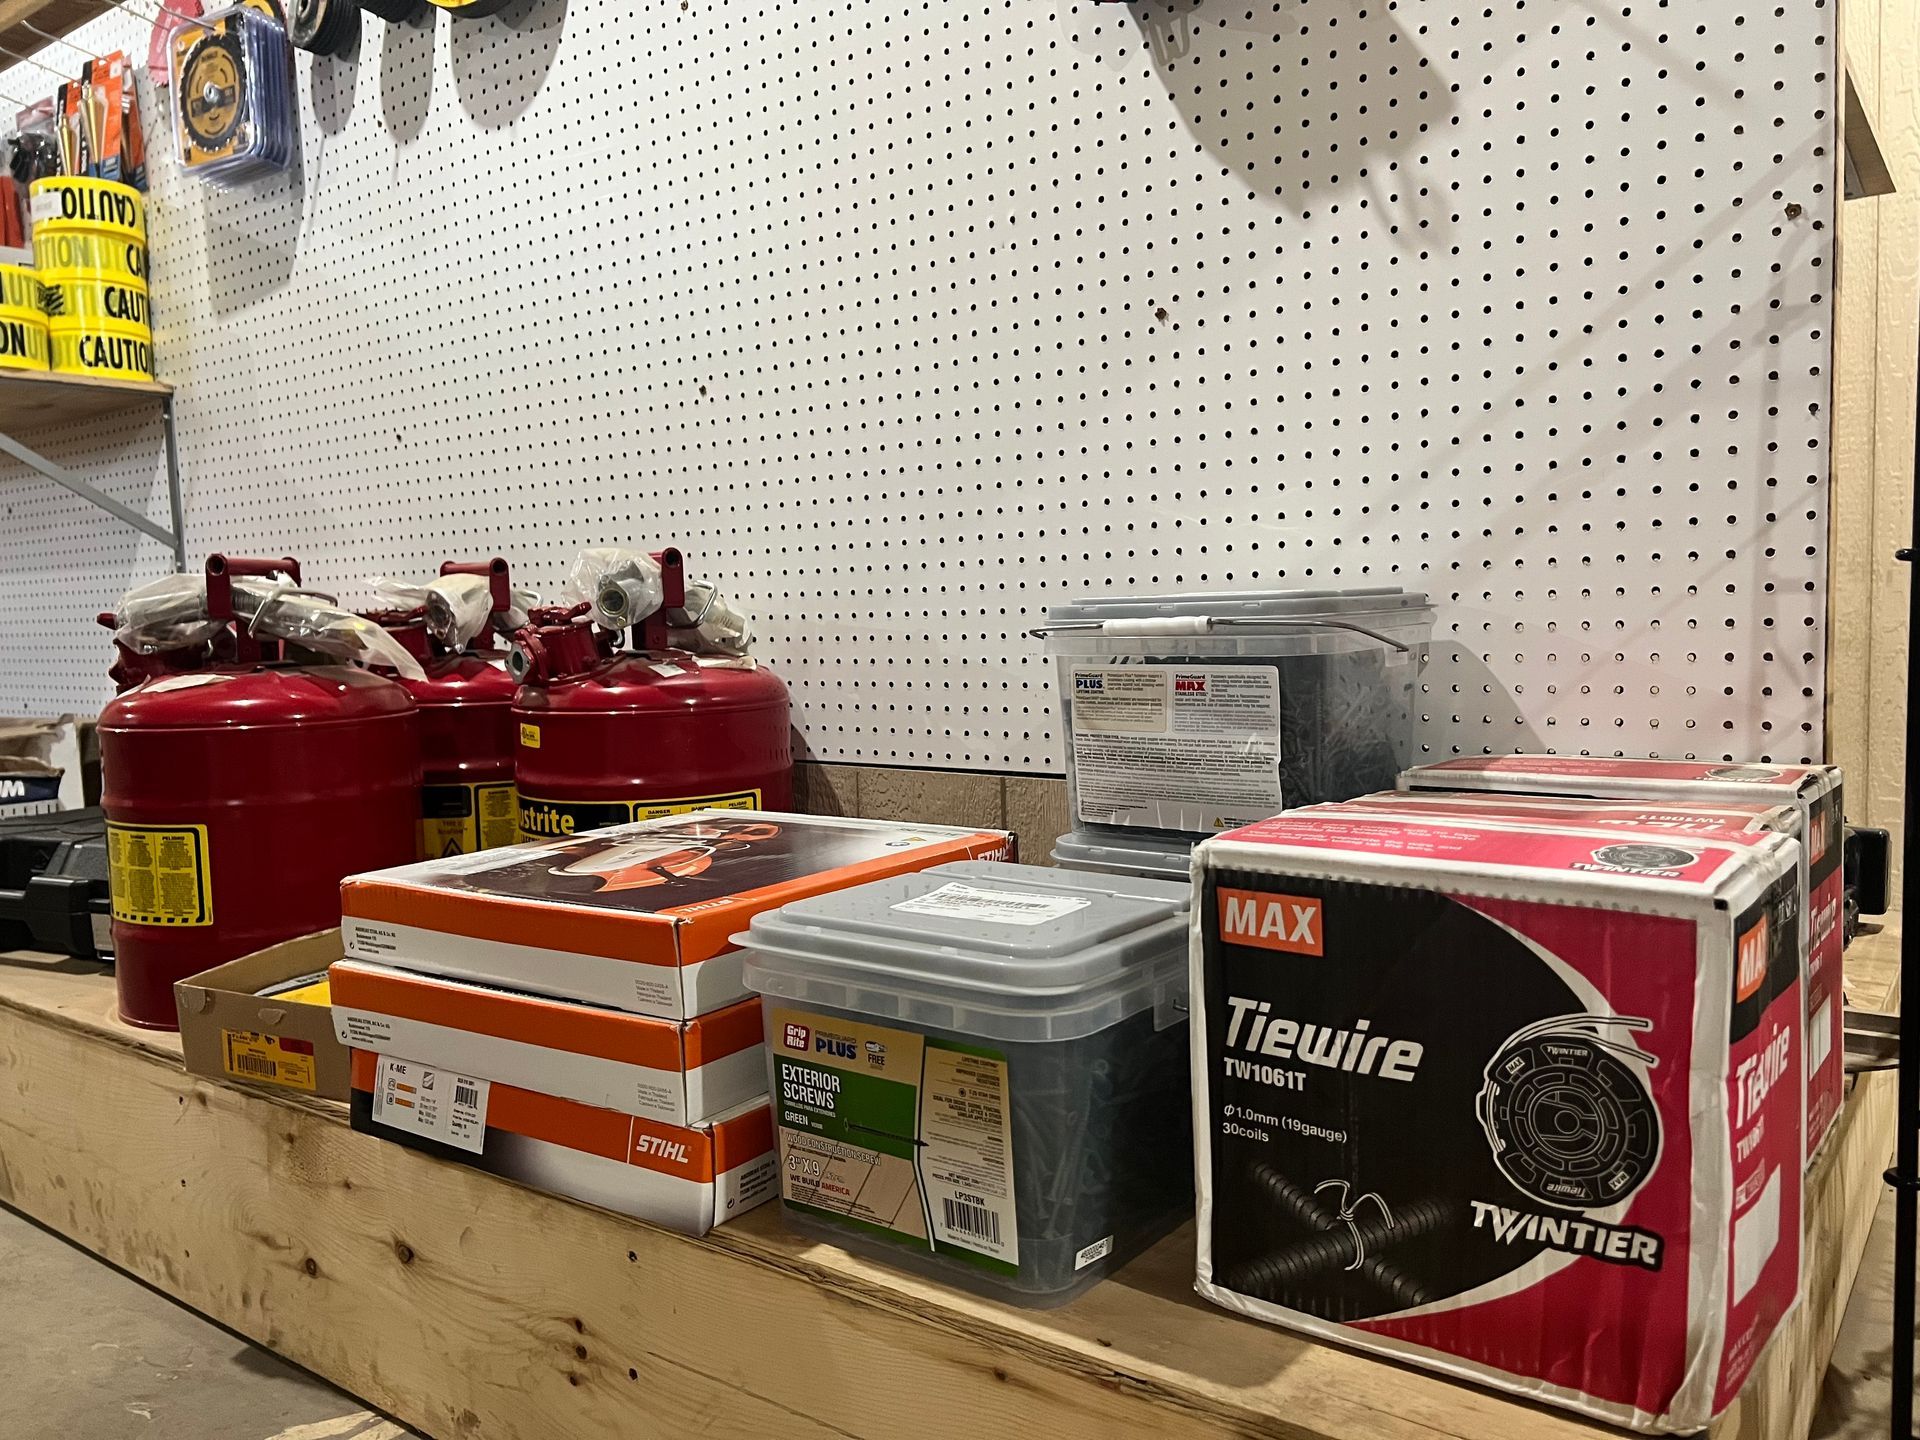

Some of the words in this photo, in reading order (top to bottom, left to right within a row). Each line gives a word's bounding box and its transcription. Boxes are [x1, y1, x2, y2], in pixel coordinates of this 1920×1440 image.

[57, 187, 135, 228] CAUTIO
[1076, 680, 1103, 689] PLUS
[1175, 681, 1205, 691] MAX
[1573, 862, 1681, 877] TWINTIER
[1224, 896, 1317, 944] MAX
[1739, 924, 1767, 990] MA
[787, 1025, 806, 1038] Grip
[787, 1036, 804, 1048] Rite
[1226, 996, 1424, 1082] Tiewire
[816, 1037, 856, 1059] PLUS
[1546, 1046, 1588, 1057] TWINTIER
[868, 1053, 885, 1066] FREE
[1508, 1058, 1524, 1073] MAX
[782, 1063, 840, 1093] EXTERIOR
[1223, 1057, 1307, 1091] TW1061T
[783, 1082, 835, 1109] SCREWS
[785, 1111, 808, 1126] GREEN
[1282, 1116, 1347, 1143] (19gauge)
[1222, 1122, 1269, 1142] 30coils
[636, 1134, 689, 1164] STIHL
[790, 1174, 801, 1183] WE
[802, 1177, 820, 1188] BUILD
[821, 1182, 850, 1196] AMERICA
[1547, 1183, 1587, 1198] Tiewire
[1471, 1201, 1658, 1265] TWINTIER
